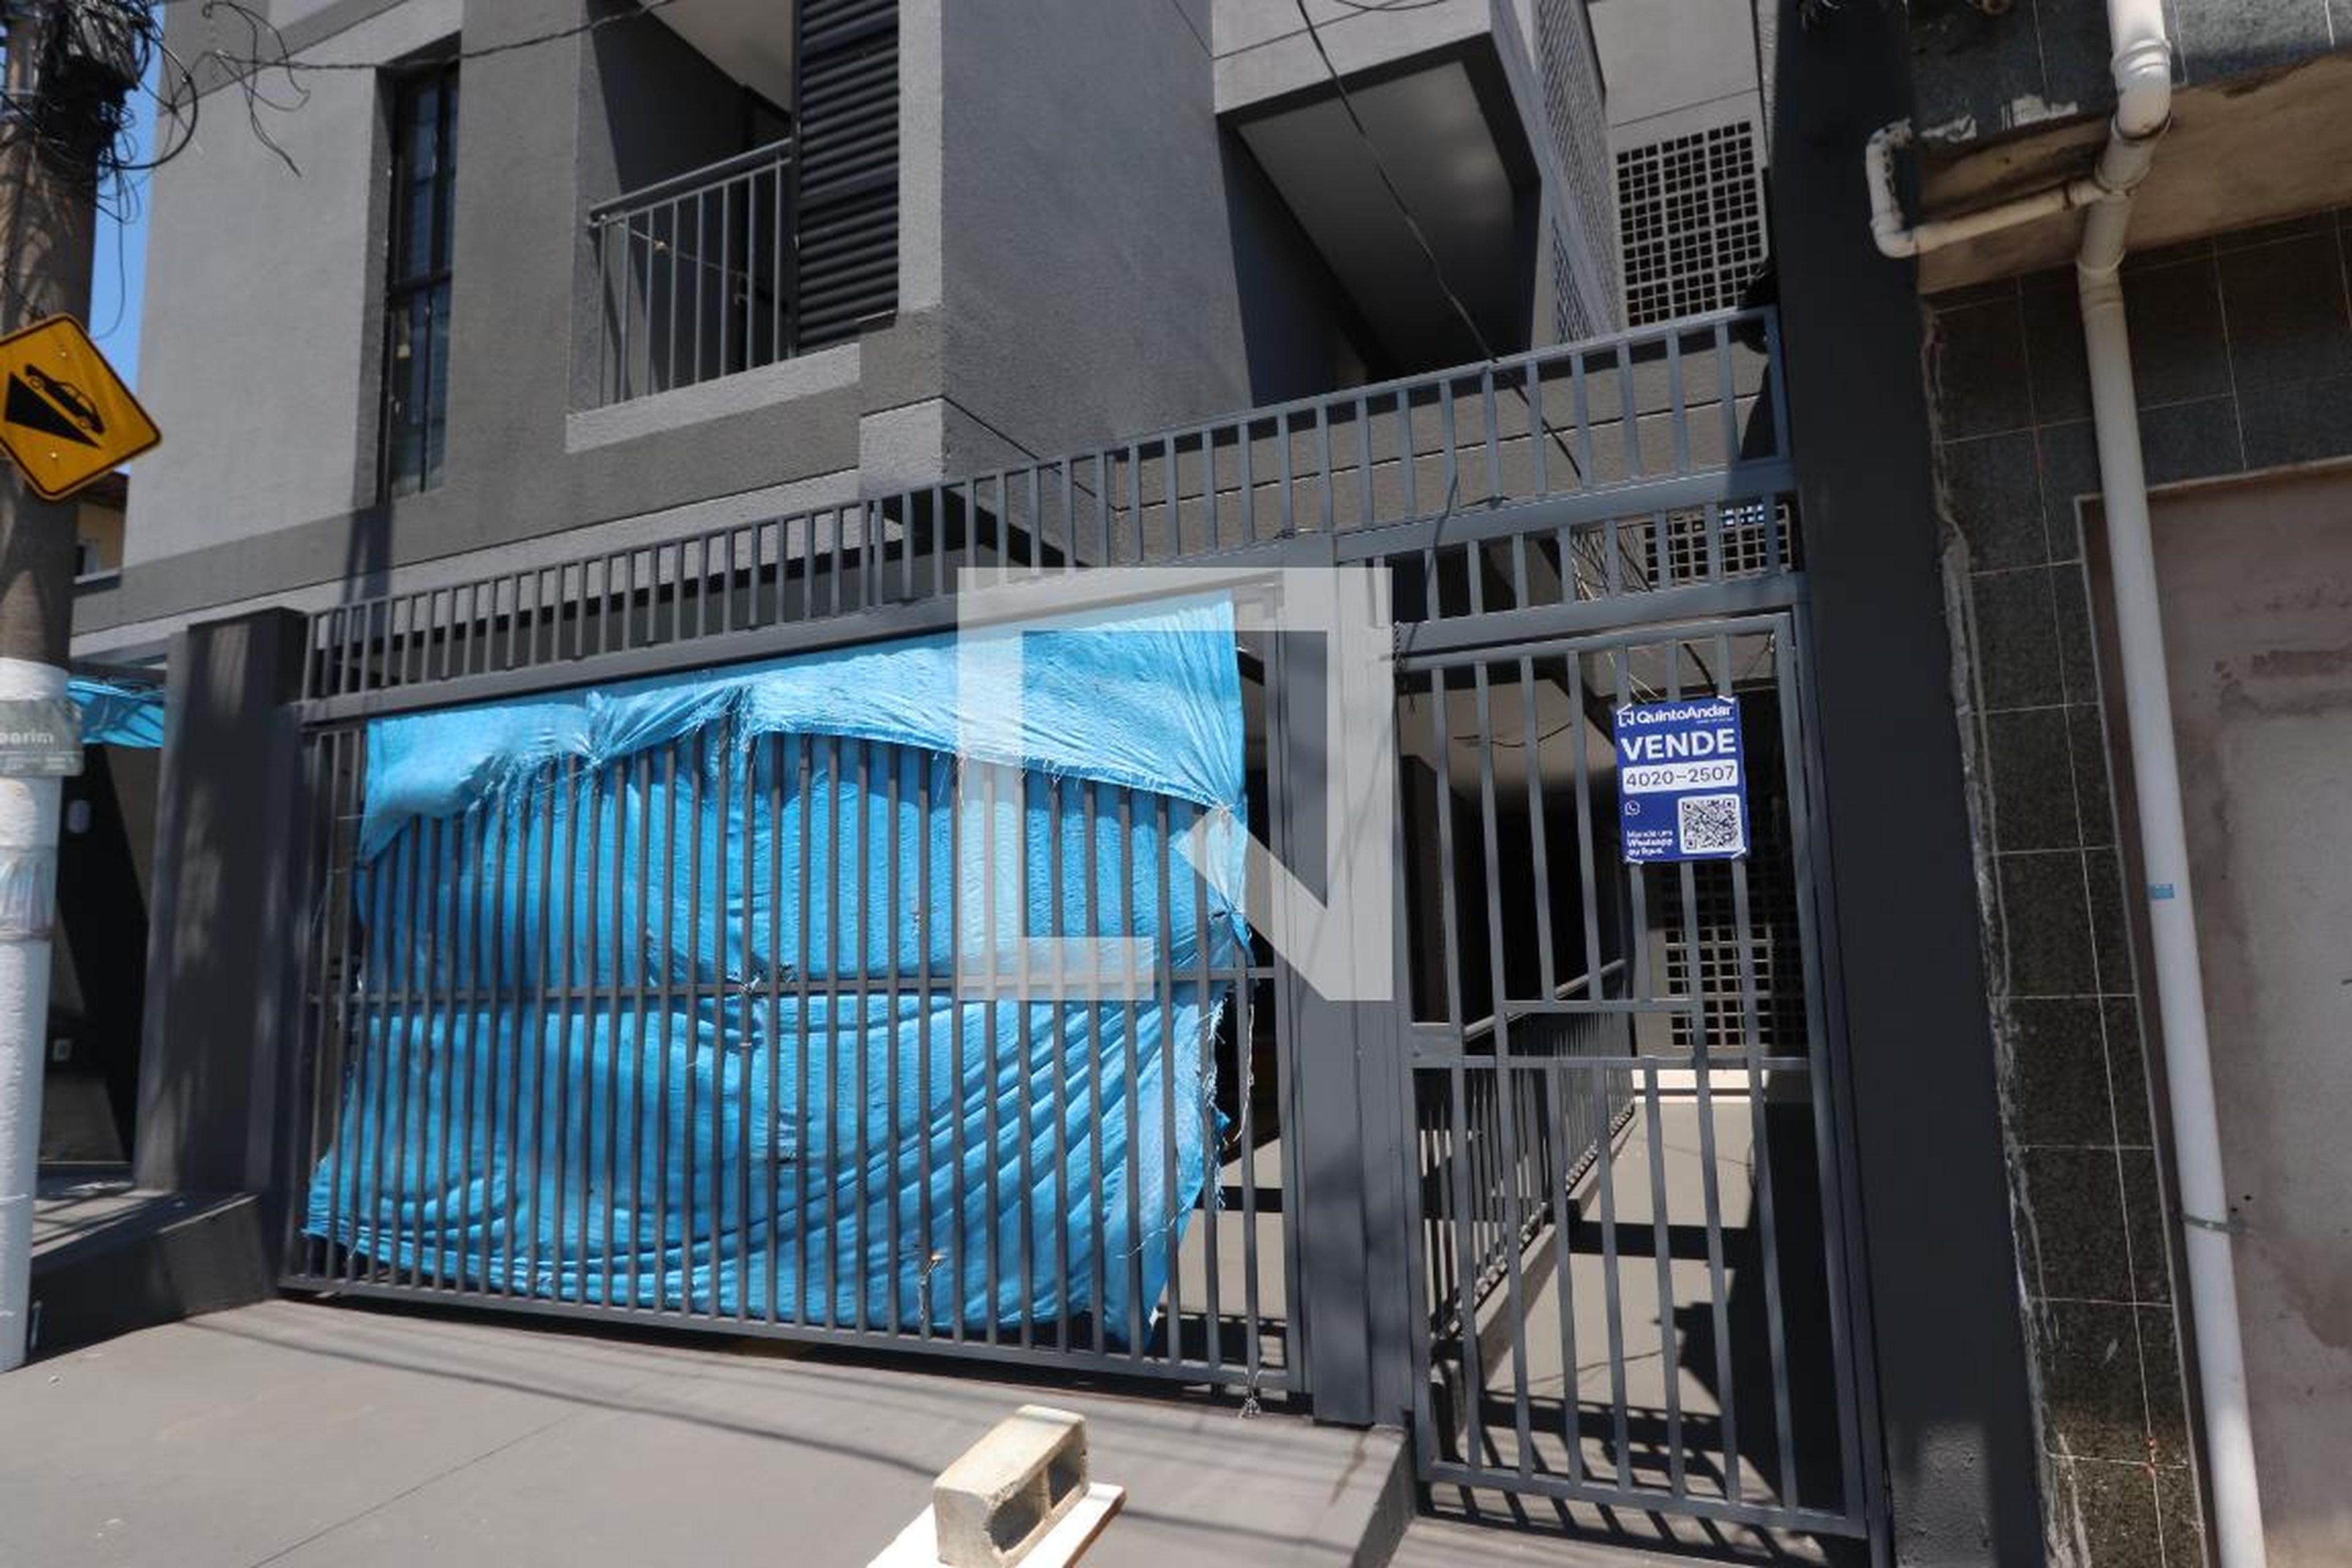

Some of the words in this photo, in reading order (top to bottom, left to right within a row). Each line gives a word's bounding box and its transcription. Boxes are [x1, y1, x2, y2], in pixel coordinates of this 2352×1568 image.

[1637, 704, 1732, 723] QuintoAndar
[1621, 728, 1736, 761] VENDE
[1626, 766, 1735, 787] 4020-2507
